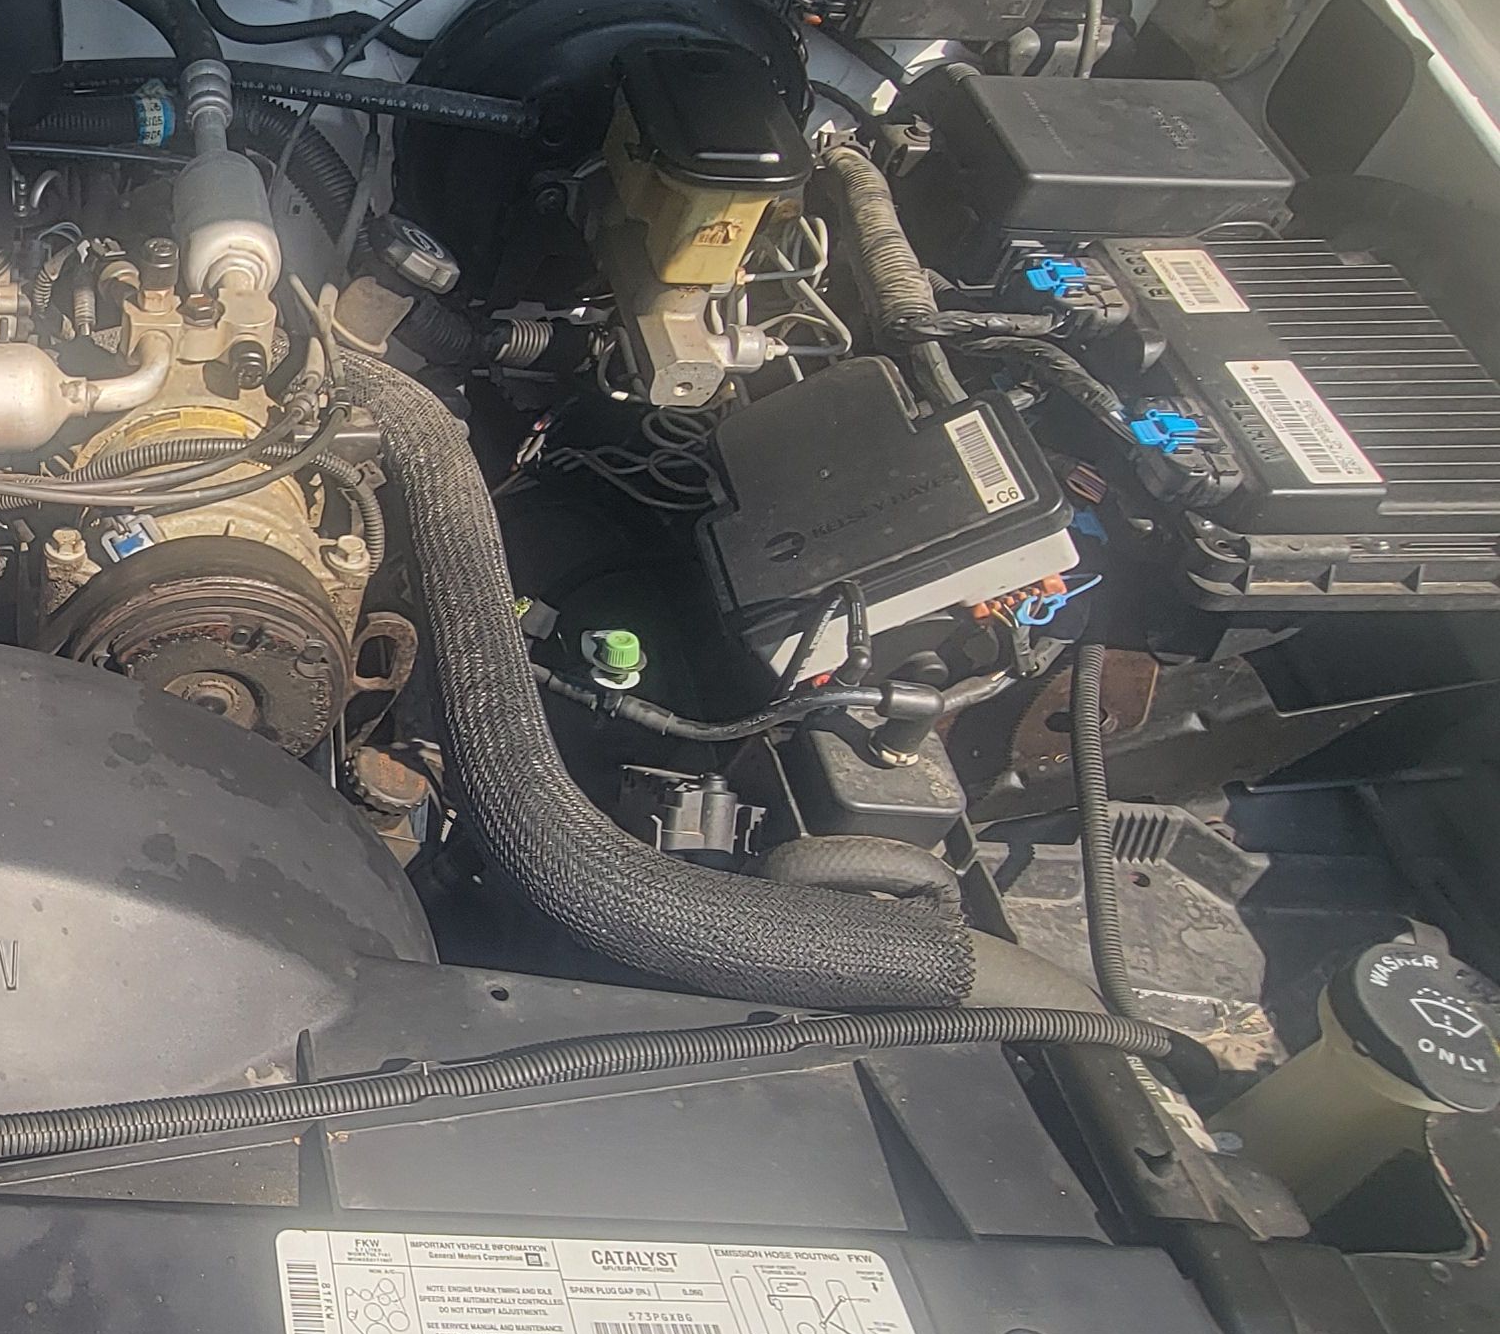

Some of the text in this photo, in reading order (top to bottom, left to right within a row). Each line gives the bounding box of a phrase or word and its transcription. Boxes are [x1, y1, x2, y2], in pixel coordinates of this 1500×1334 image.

[996, 486, 1019, 504] C6
[1369, 954, 1439, 987] WASHER
[1418, 1038, 1487, 1073] ONLY
[355, 1239, 379, 1247] FKW
[409, 1241, 547, 1252] IMPORTANT VEHICLE INFORMATION
[429, 1251, 456, 1259] General
[484, 1253, 523, 1262] Corporation
[591, 1250, 678, 1267] CATALYST
[714, 1249, 872, 1264] EMISSION HOSE ROUTING FKW
[596, 1287, 617, 1295] PLUG
[322, 1283, 334, 1320] 81FKW
